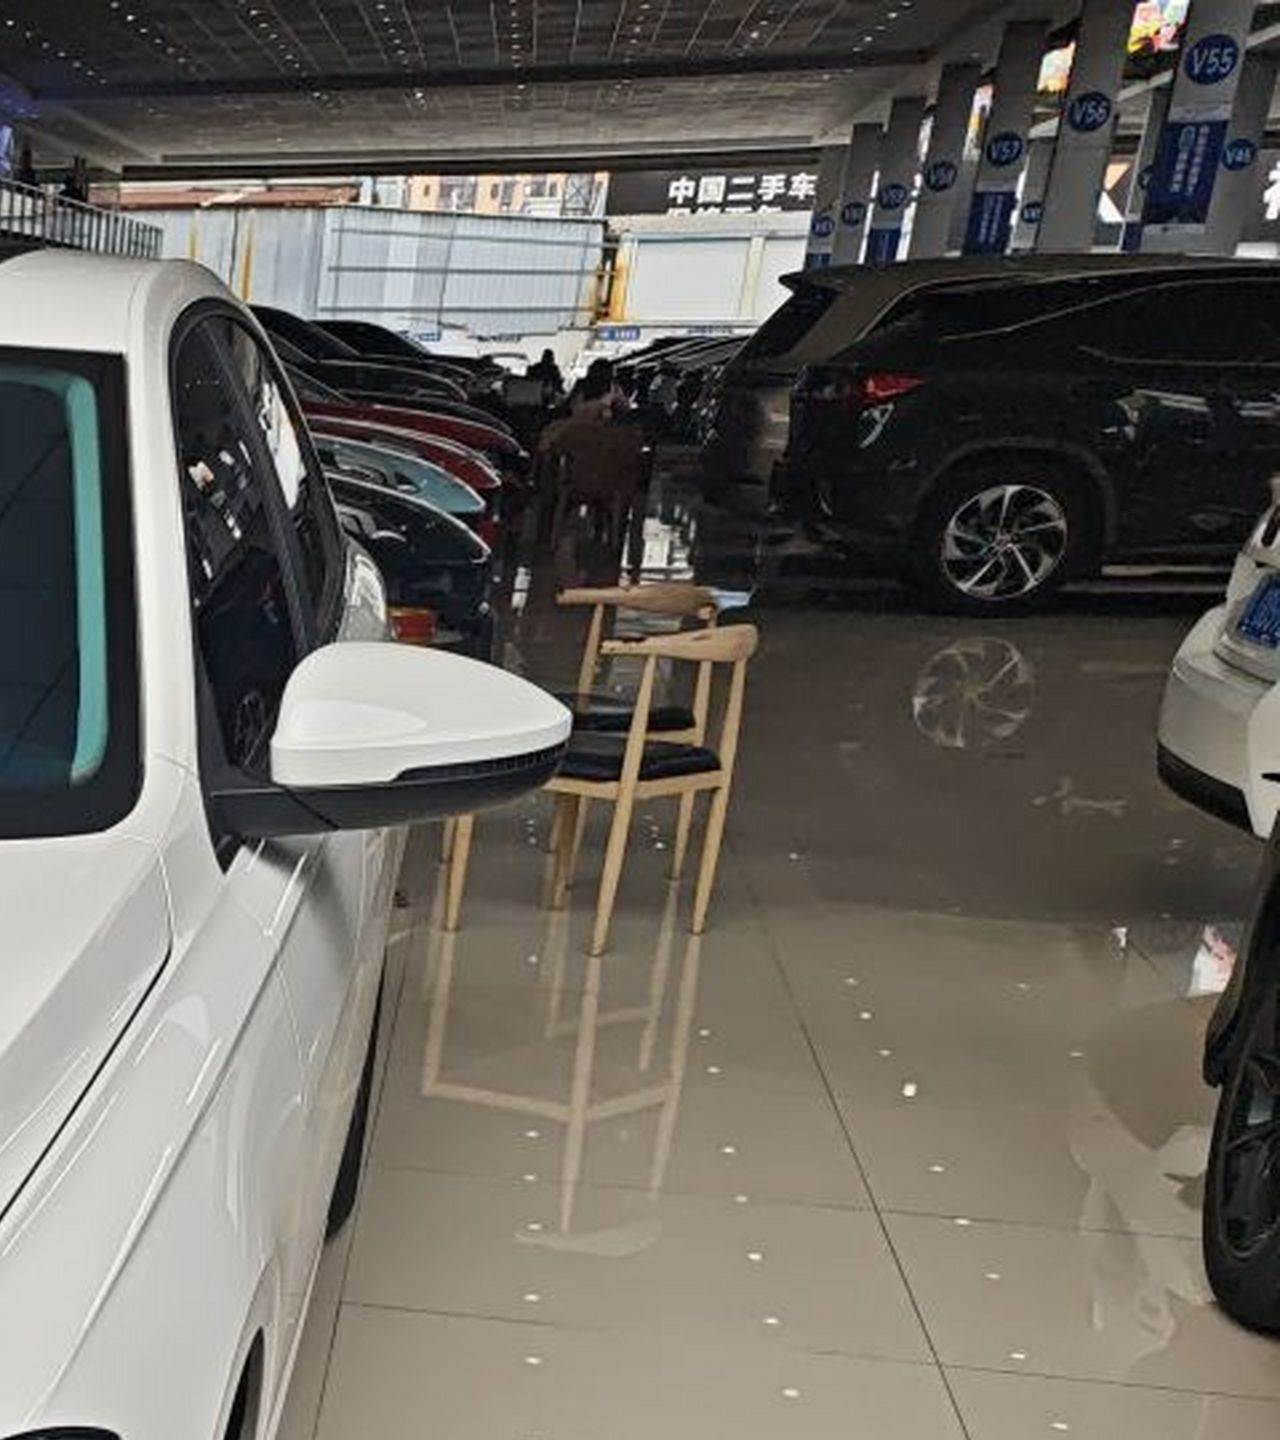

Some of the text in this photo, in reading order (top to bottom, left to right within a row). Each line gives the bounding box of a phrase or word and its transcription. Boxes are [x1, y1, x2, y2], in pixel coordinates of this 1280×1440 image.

[1191, 46, 1235, 76] V55
[1074, 100, 1109, 124] V56
[990, 139, 1020, 162] V57
[668, 172, 818, 204] 中国二手车
